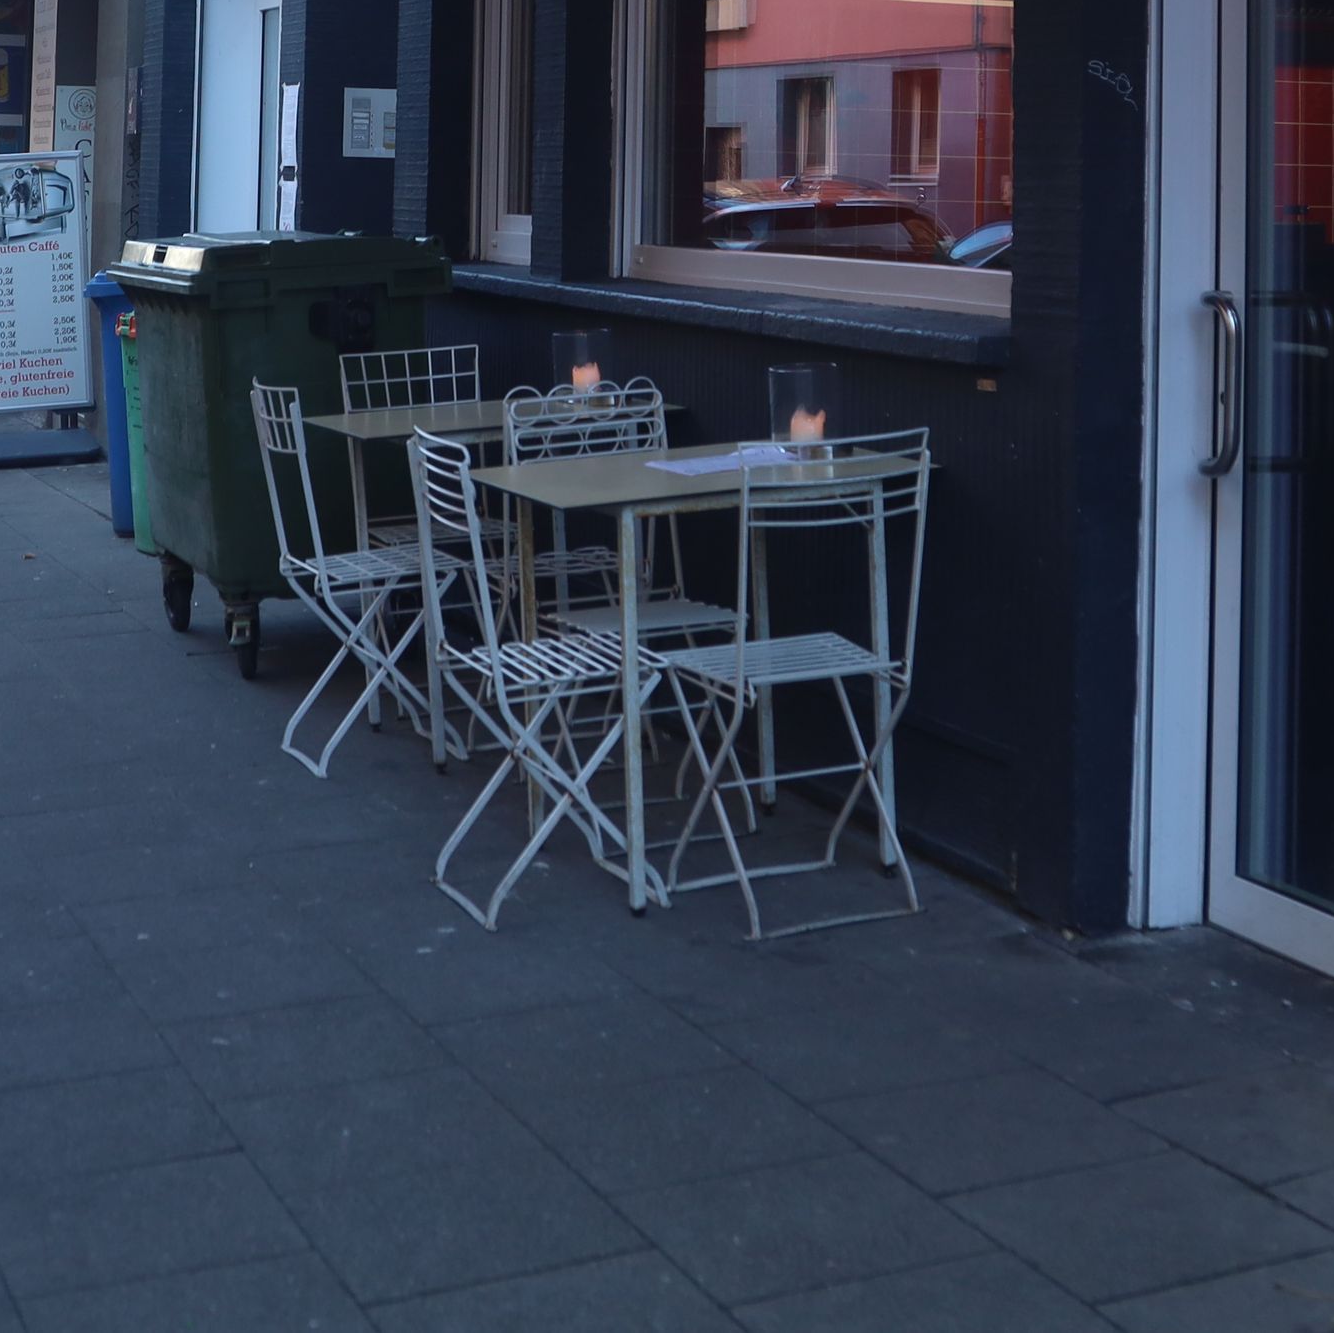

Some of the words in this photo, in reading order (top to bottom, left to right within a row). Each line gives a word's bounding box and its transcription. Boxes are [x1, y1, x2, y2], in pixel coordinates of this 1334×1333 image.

[19, 356, 63, 368] Kuchen
[10, 369, 75, 384] glutenfreie
[22, 384, 70, 397] Kuchen)
